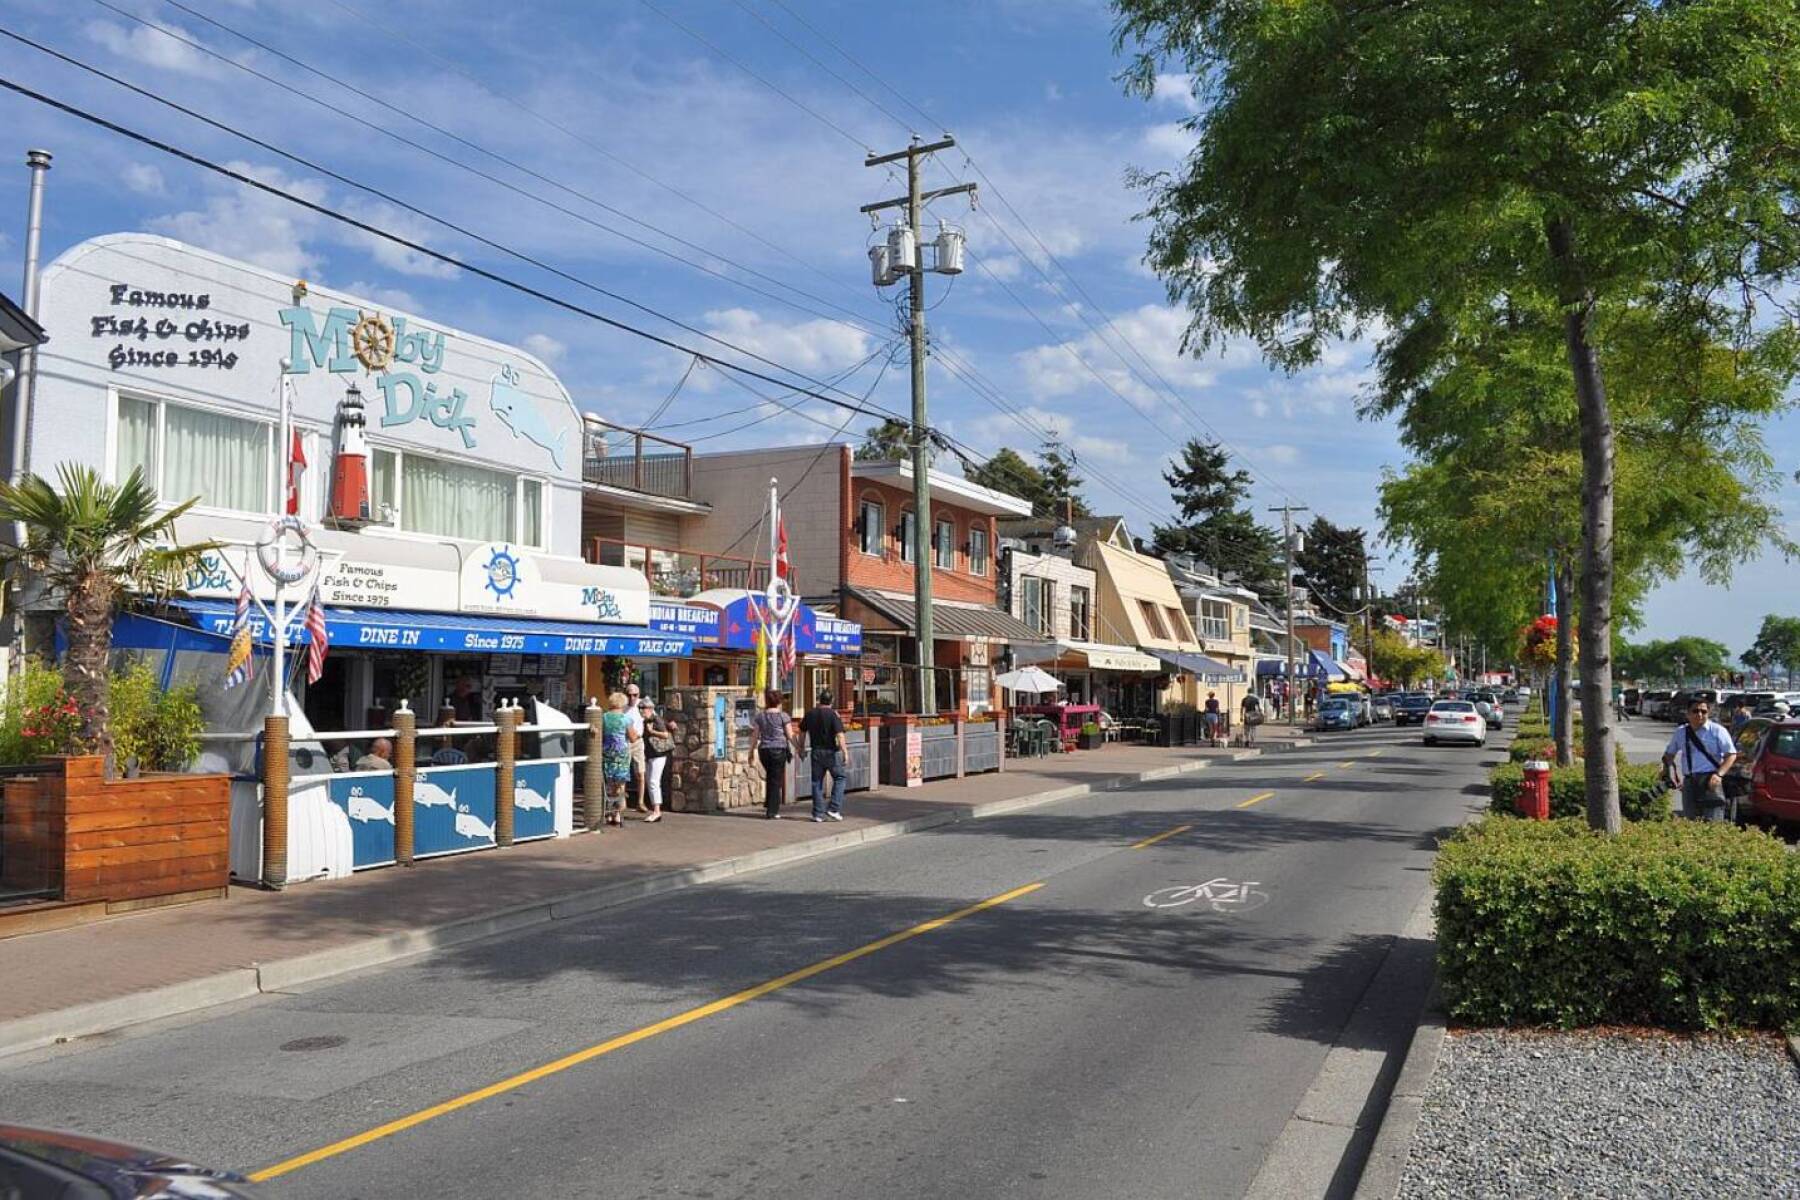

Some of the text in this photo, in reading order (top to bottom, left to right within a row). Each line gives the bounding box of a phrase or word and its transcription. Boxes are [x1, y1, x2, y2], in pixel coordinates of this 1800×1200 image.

[110, 284, 210, 310] Famous
[91, 315, 250, 342] Fish & Chips
[108, 344, 178, 371] Since
[376, 371, 477, 449] Dick
[186, 566, 232, 592] Dick
[339, 563, 384, 576] Famous
[323, 575, 350, 587] Fish
[365, 578, 398, 591] Chips
[331, 591, 390, 606] Since 1975
[597, 604, 622, 620] Dick
[677, 608, 719, 624] BREAKFAST
[359, 627, 685, 654] DINE IN Since 1975 DINE IN TAKE OUT
